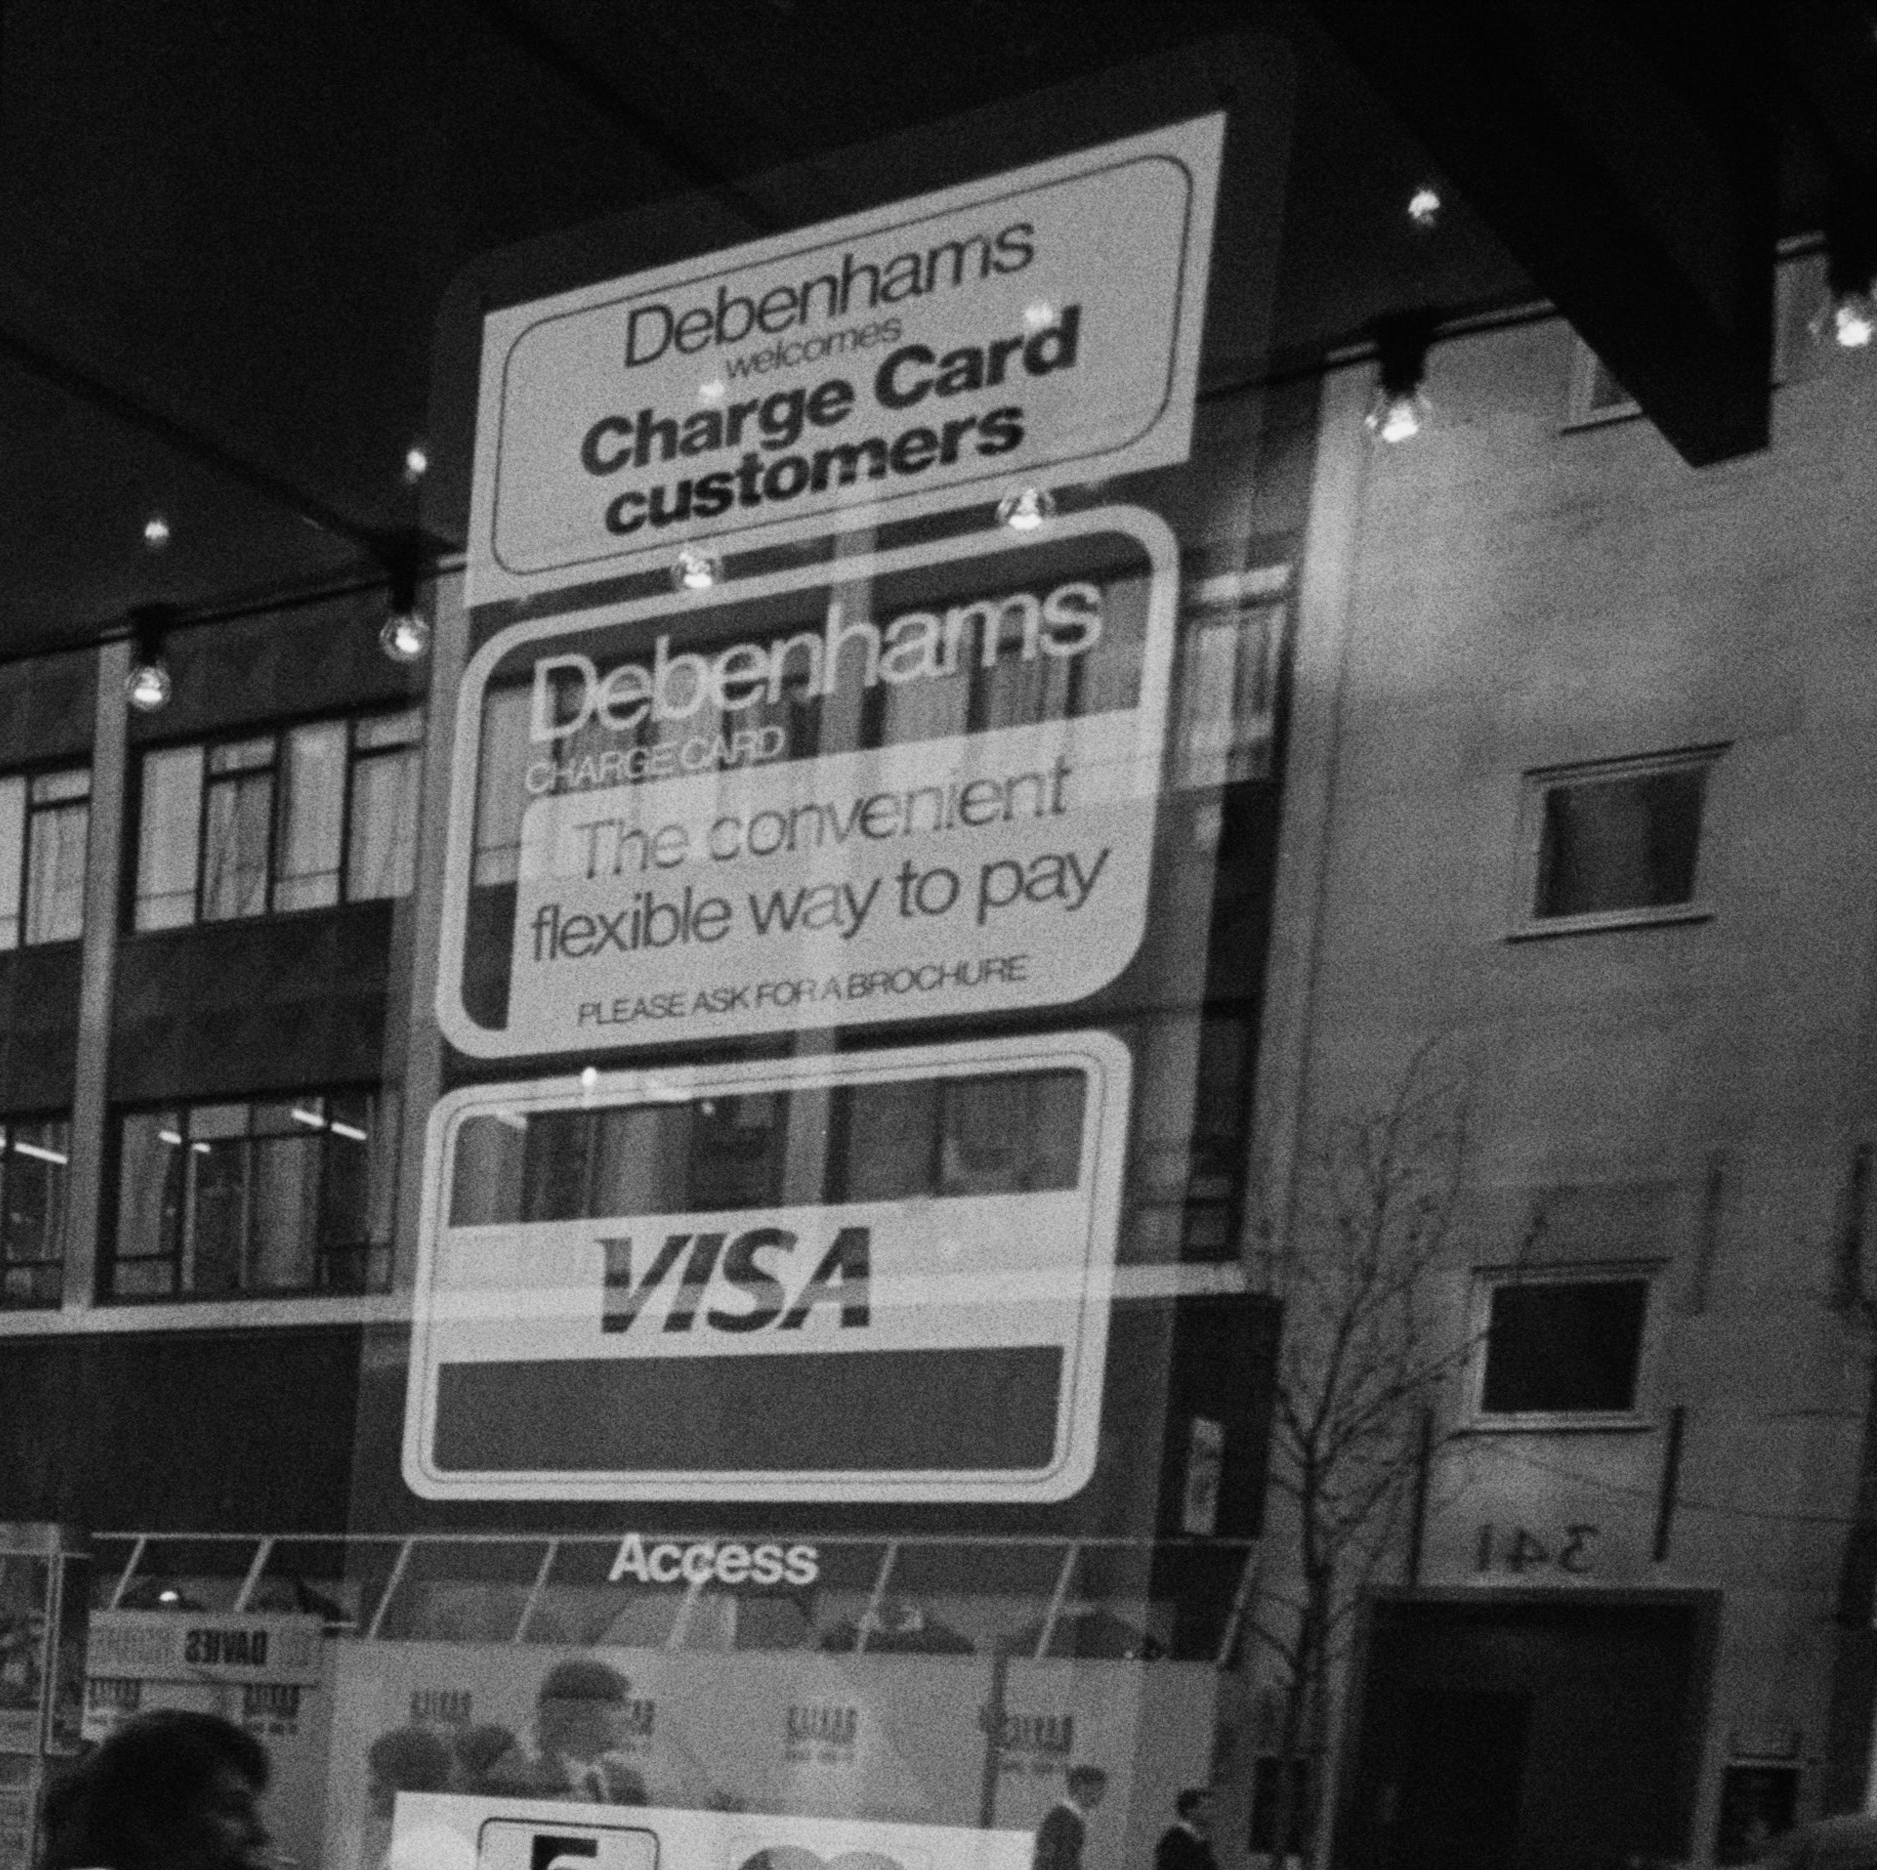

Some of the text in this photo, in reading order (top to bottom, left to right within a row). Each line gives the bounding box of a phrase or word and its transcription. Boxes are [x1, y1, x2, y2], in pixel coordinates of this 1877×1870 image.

[624, 220, 1035, 368] Debenhams
[725, 315, 904, 381] welcomes
[579, 304, 1082, 477] Charge Card
[604, 404, 1026, 537] customers
[531, 579, 1103, 744] Debenhams
[525, 727, 785, 795] CHARGE CARD
[572, 756, 1074, 881] The convenient
[528, 846, 1113, 962] flexible way to pay
[578, 953, 1031, 1028] PLEASE ASK FOR A BROCHURE
[594, 1226, 872, 1334] VISA
[608, 1531, 820, 1587] Access
